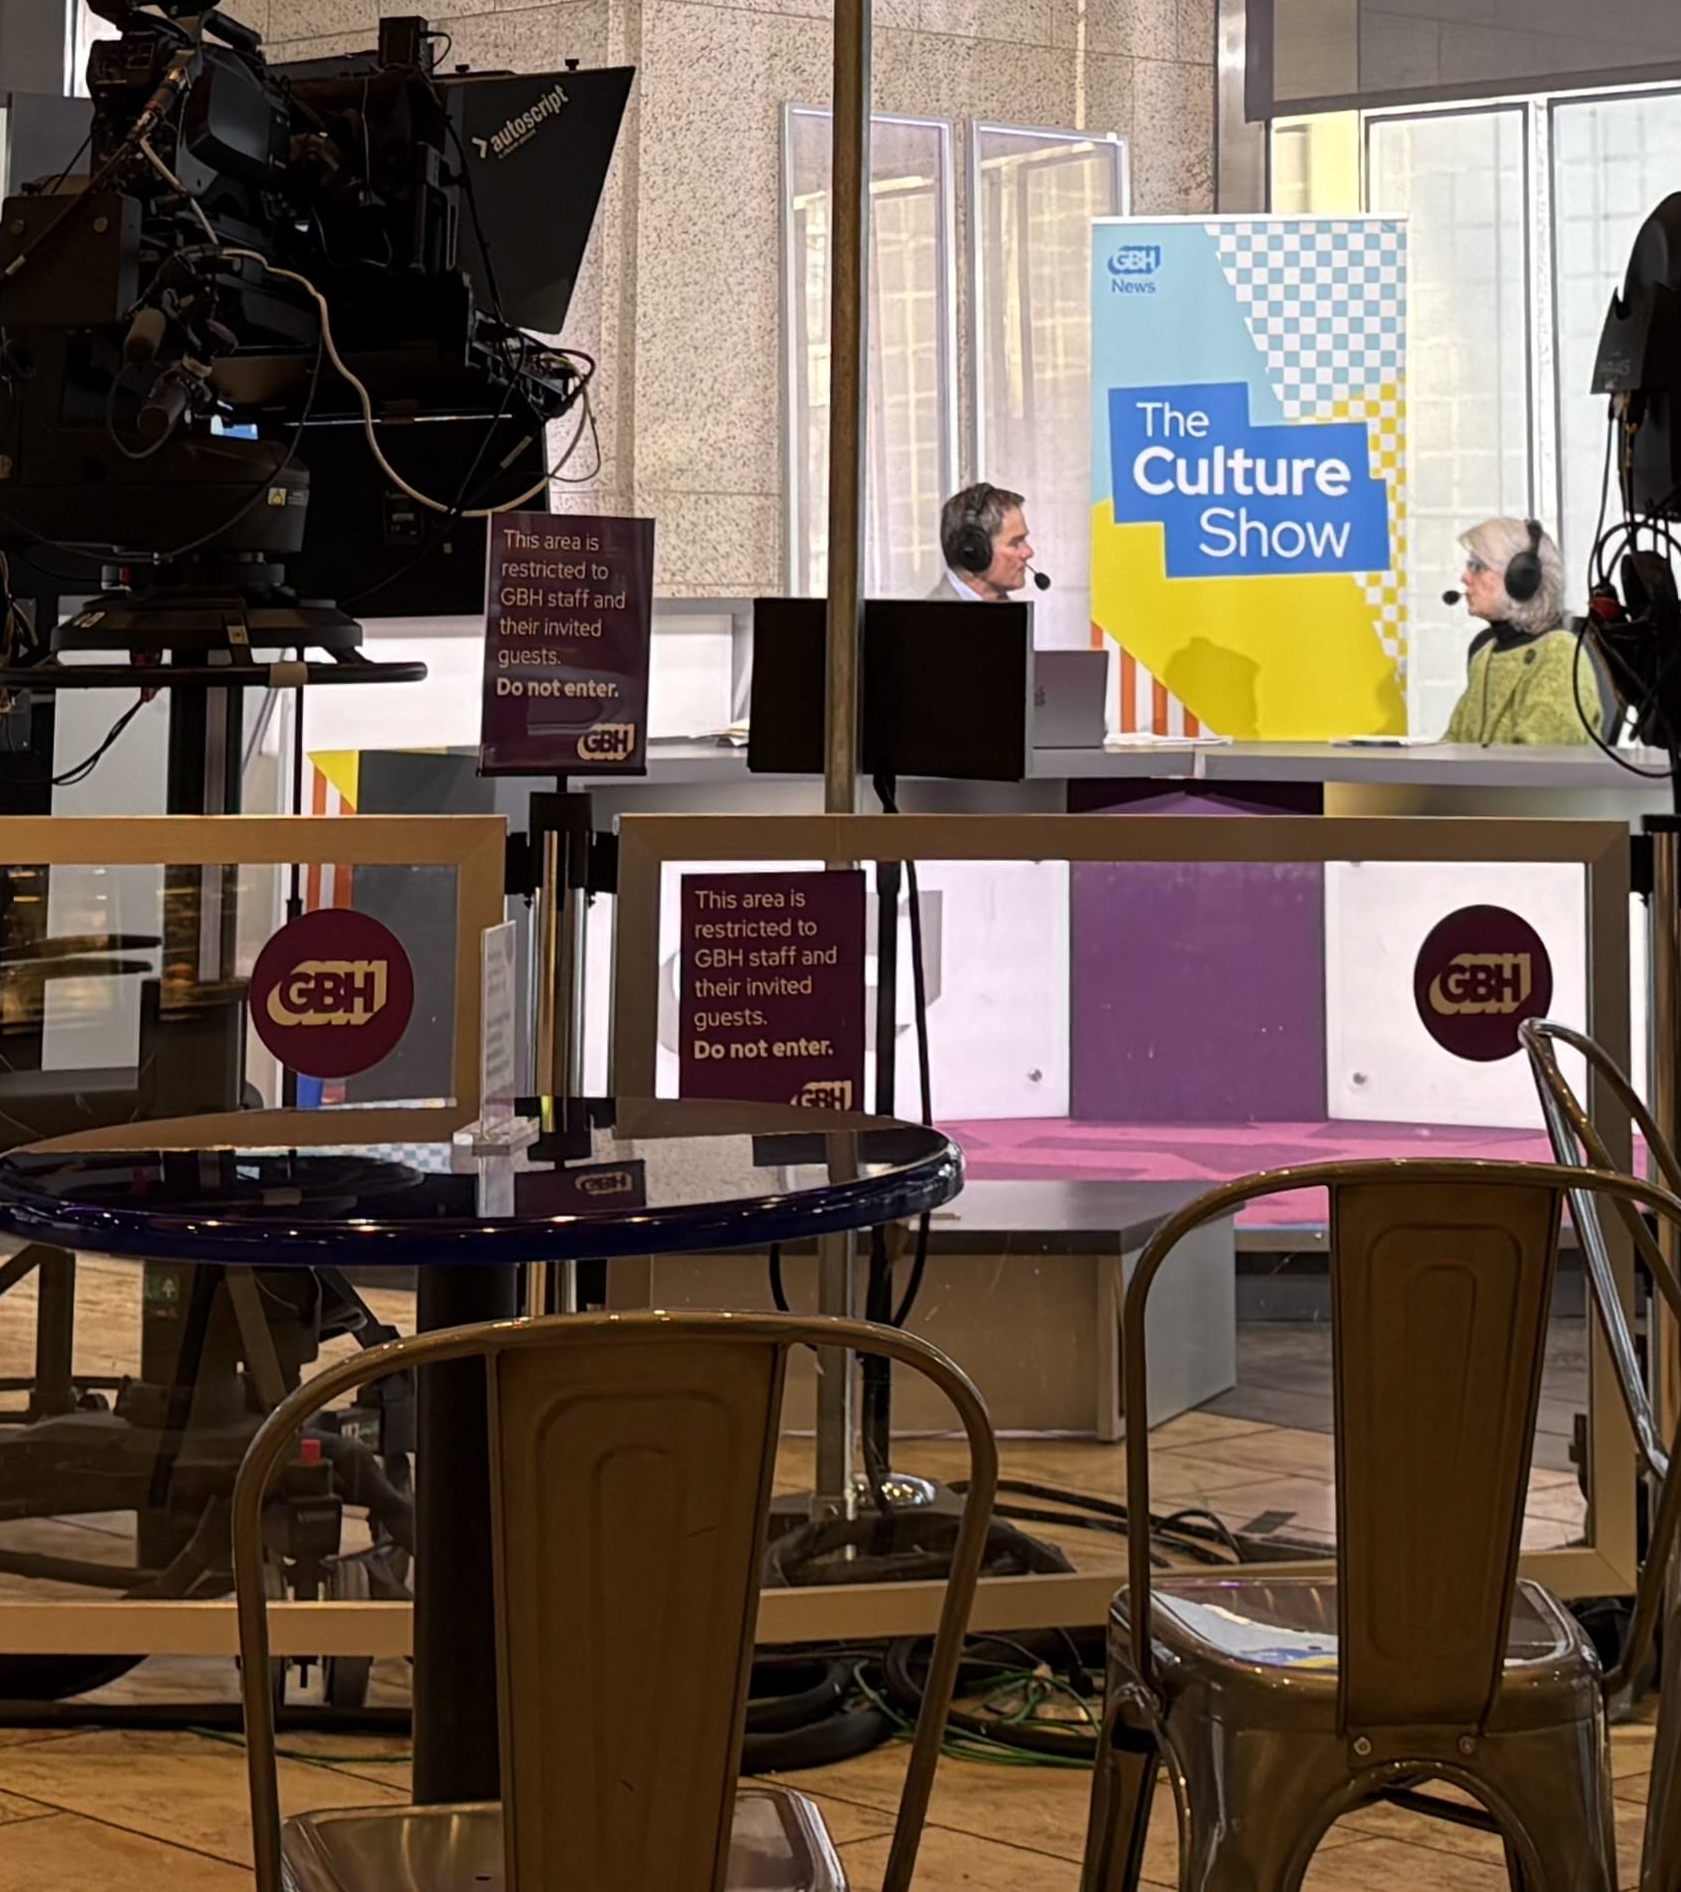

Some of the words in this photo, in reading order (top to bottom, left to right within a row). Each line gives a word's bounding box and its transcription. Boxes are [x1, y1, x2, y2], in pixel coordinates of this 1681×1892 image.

[490, 84, 569, 153] autoscript
[1108, 245, 1161, 275] GBH
[1111, 279, 1156, 294] News
[1136, 401, 1210, 438] The
[1133, 445, 1352, 496] Culture
[503, 529, 540, 549] This
[544, 534, 581, 550] area
[586, 533, 599, 551] is
[1199, 507, 1352, 558] Show
[501, 560, 586, 580] restricted
[591, 563, 609, 580] to
[500, 587, 543, 607] GBH
[547, 588, 590, 608] staff
[593, 591, 626, 609] and
[499, 616, 540, 636] their
[544, 618, 602, 637] invited
[498, 648, 561, 668] guests.
[496, 677, 524, 696] Do
[527, 678, 561, 697] not
[564, 680, 619, 698] enter.
[577, 723, 635, 761] GBH
[694, 890, 737, 909] This
[742, 892, 785, 908] area
[790, 889, 806, 907] is
[694, 917, 791, 938] restricted
[797, 919, 817, 936] to
[694, 948, 743, 968] GBH
[749, 946, 797, 966] staff
[801, 946, 837, 965] and
[267, 960, 388, 1026] GBH
[694, 978, 741, 998] their
[746, 975, 812, 996] invited
[1429, 953, 1532, 1015] GBH
[694, 1008, 768, 1031] guests.
[694, 1040, 725, 1059] Do
[730, 1039, 768, 1058] not
[772, 1037, 834, 1055] enter.
